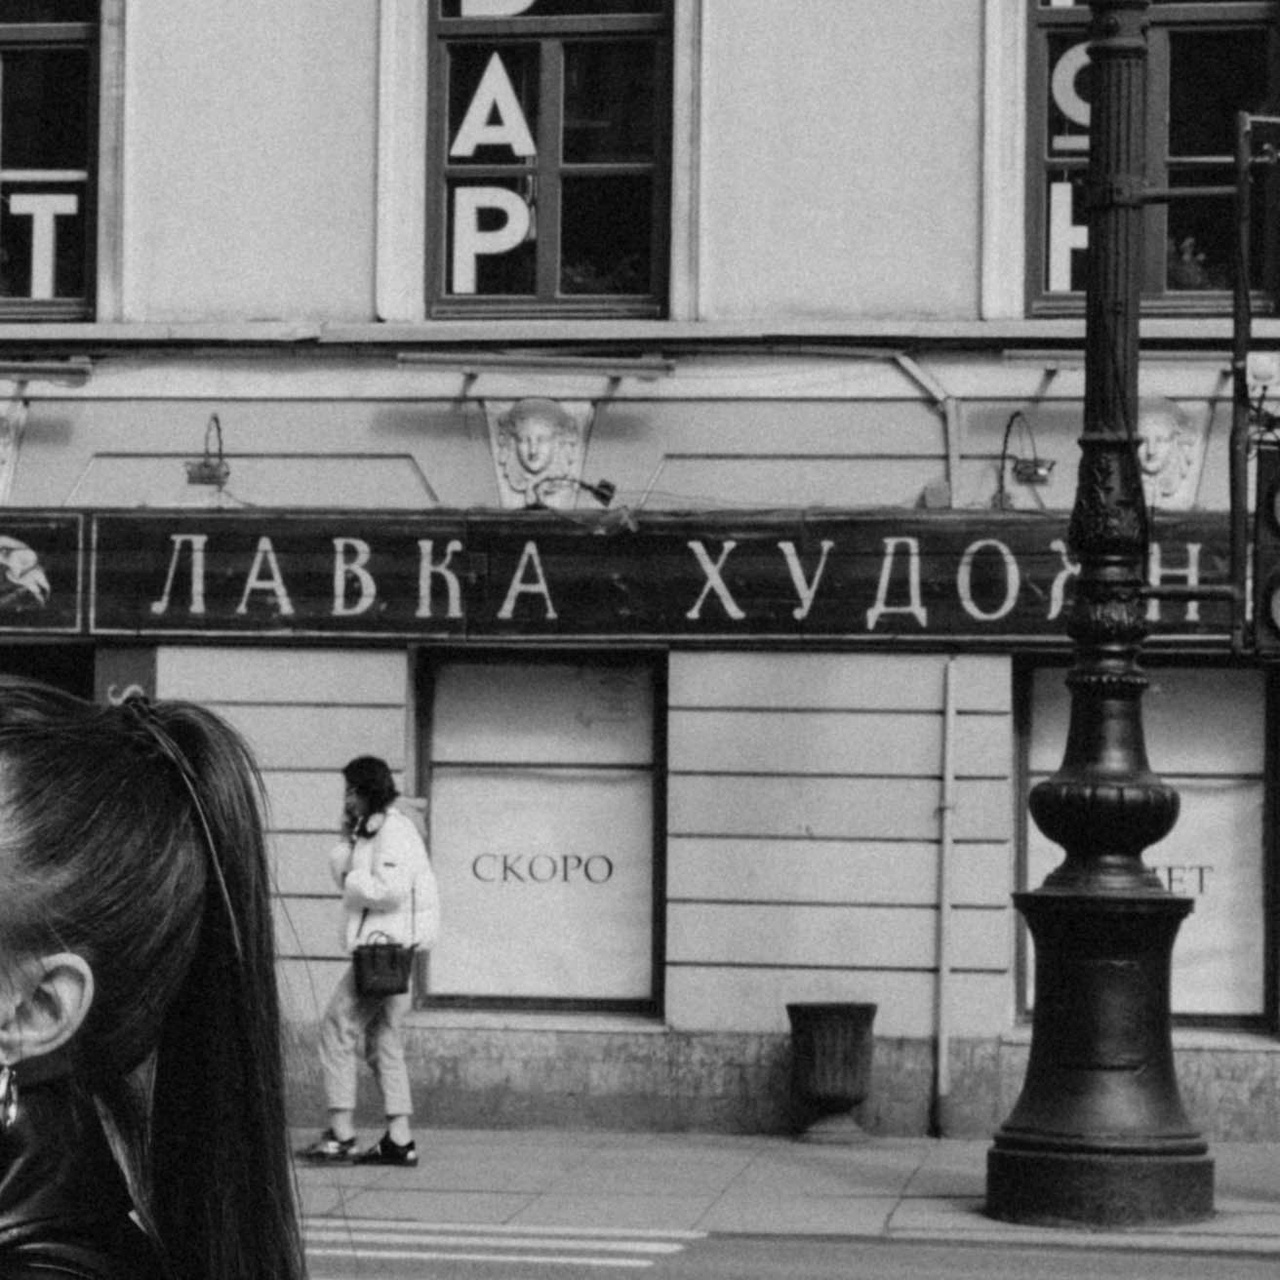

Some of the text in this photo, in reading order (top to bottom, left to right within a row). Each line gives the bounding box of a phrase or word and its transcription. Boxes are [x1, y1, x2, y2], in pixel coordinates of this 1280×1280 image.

[151, 533, 1254, 631] ЛАВКА ХУДОН
[472, 852, 614, 884] СКОРО
